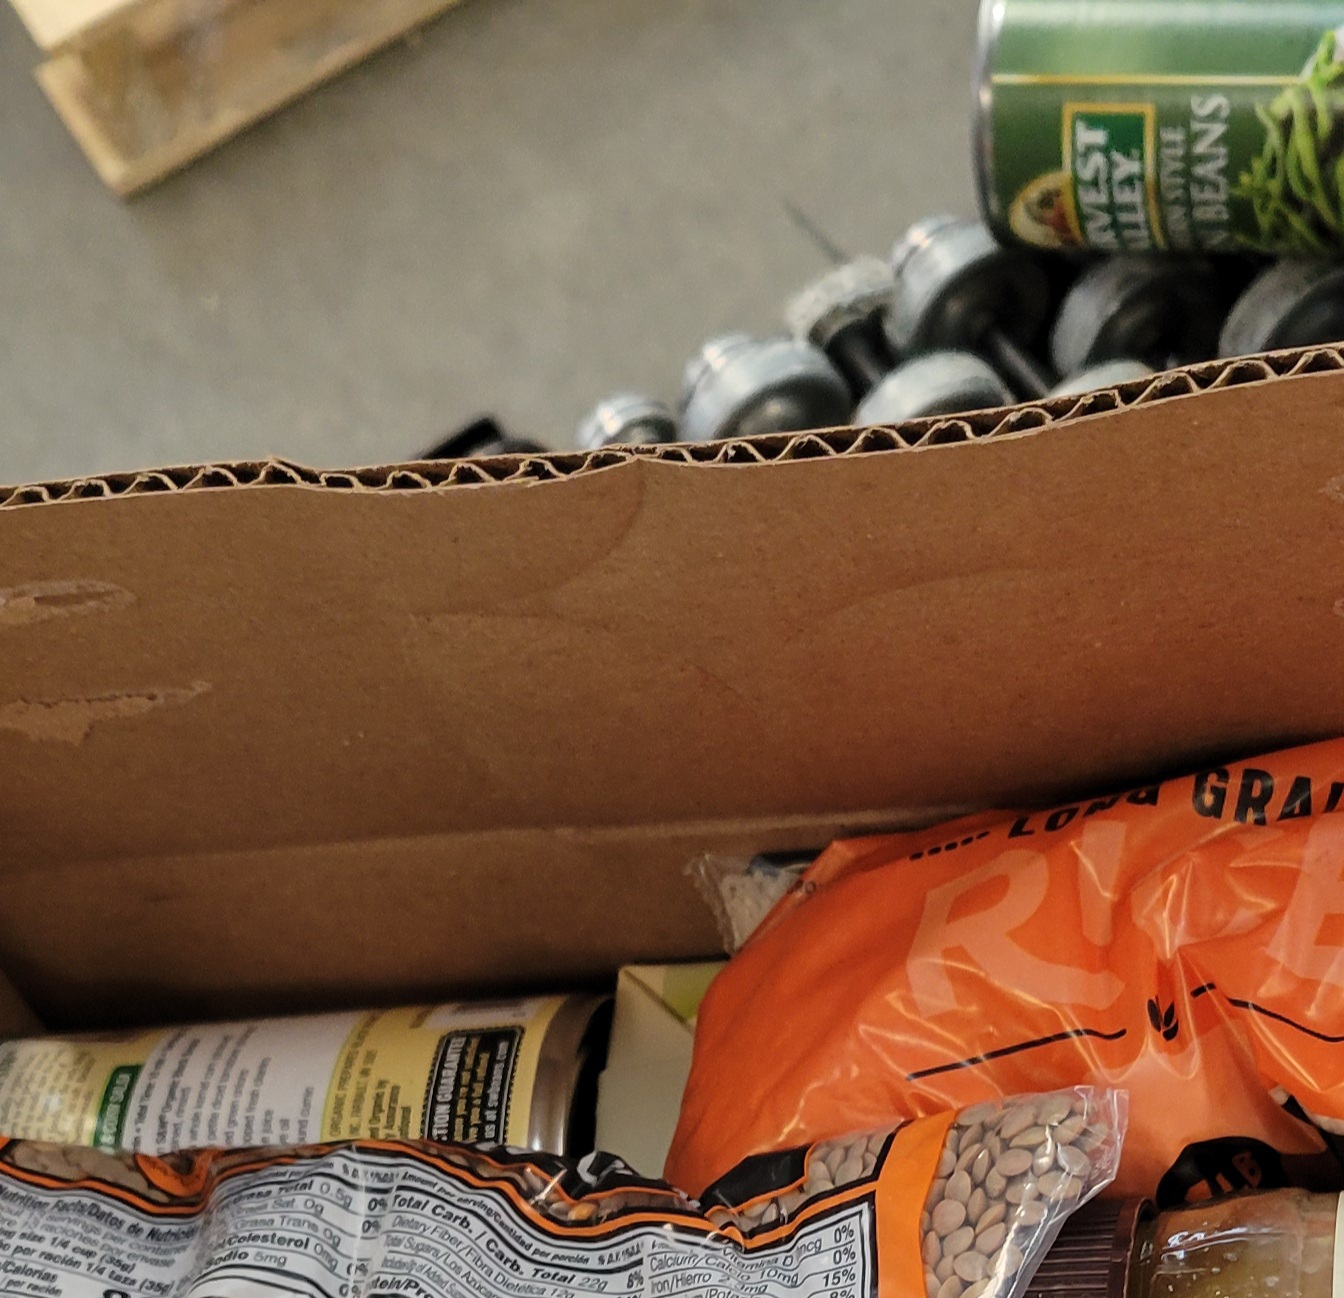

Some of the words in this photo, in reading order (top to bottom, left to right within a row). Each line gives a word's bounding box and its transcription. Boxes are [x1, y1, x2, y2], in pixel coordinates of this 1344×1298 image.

[1189, 93, 1231, 219] BEANS
[391, 1194, 429, 1211] Total
[431, 1202, 473, 1234] Carb.
[532, 1267, 575, 1285] Total
[823, 1268, 855, 1287] 15%
